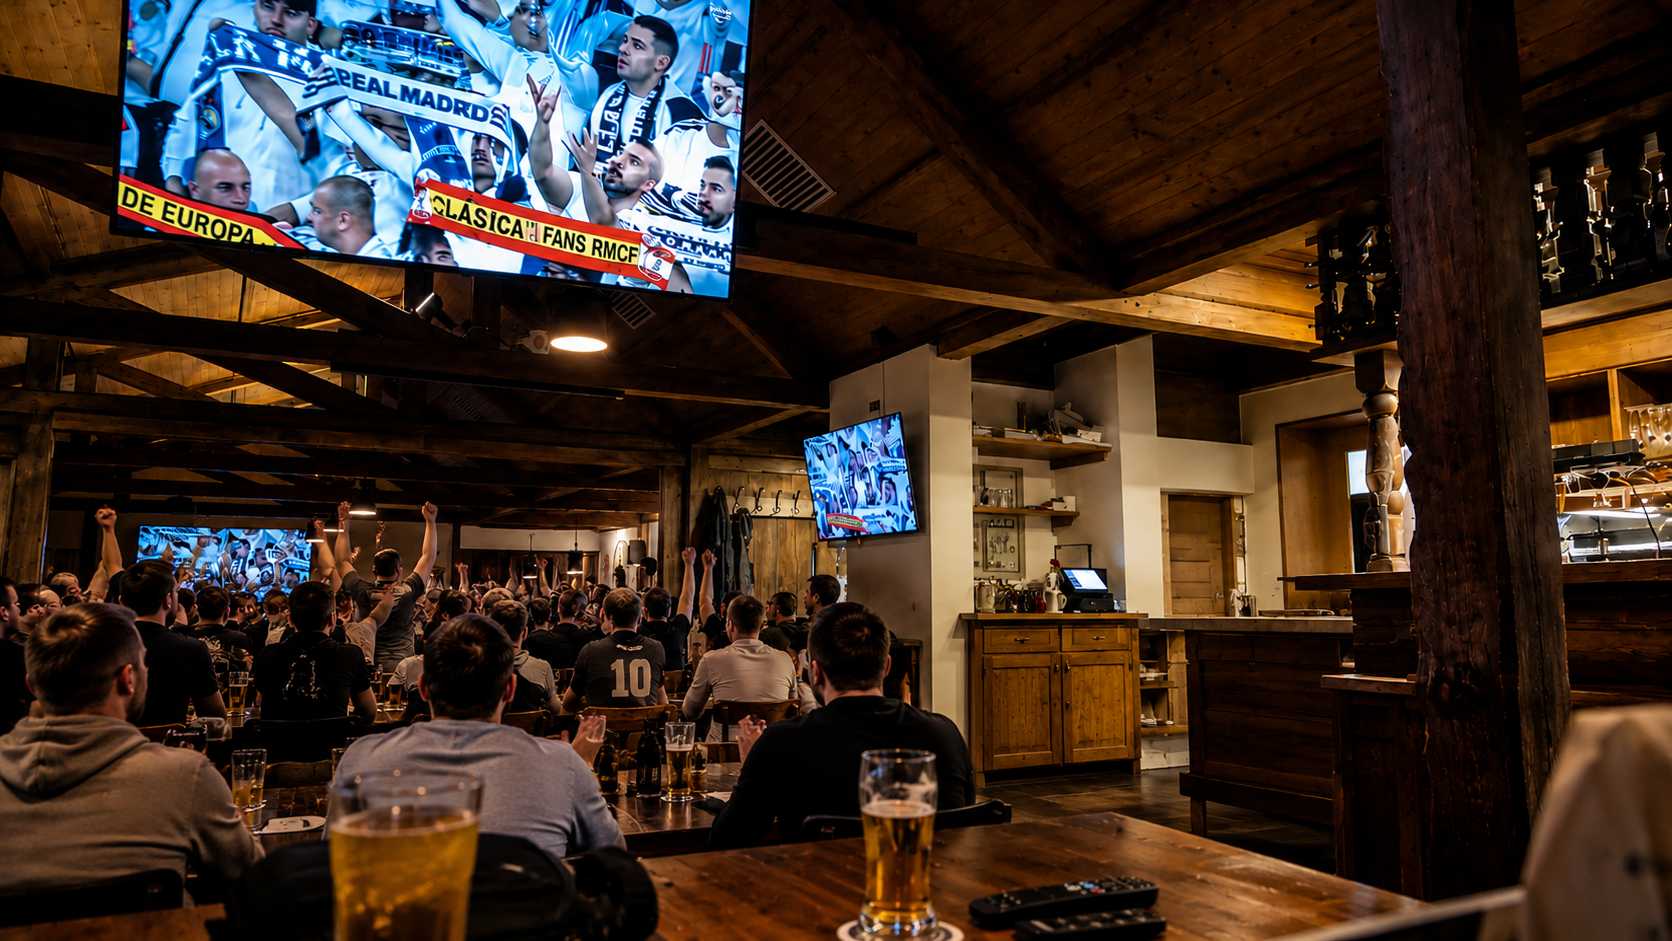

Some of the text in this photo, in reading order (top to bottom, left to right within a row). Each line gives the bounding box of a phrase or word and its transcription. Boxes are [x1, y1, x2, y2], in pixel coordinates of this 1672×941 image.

[121, 186, 255, 245] DE EUROPA
[543, 227, 587, 253] FANS
[591, 238, 639, 264] RMCF
[610, 658, 653, 698] 10
